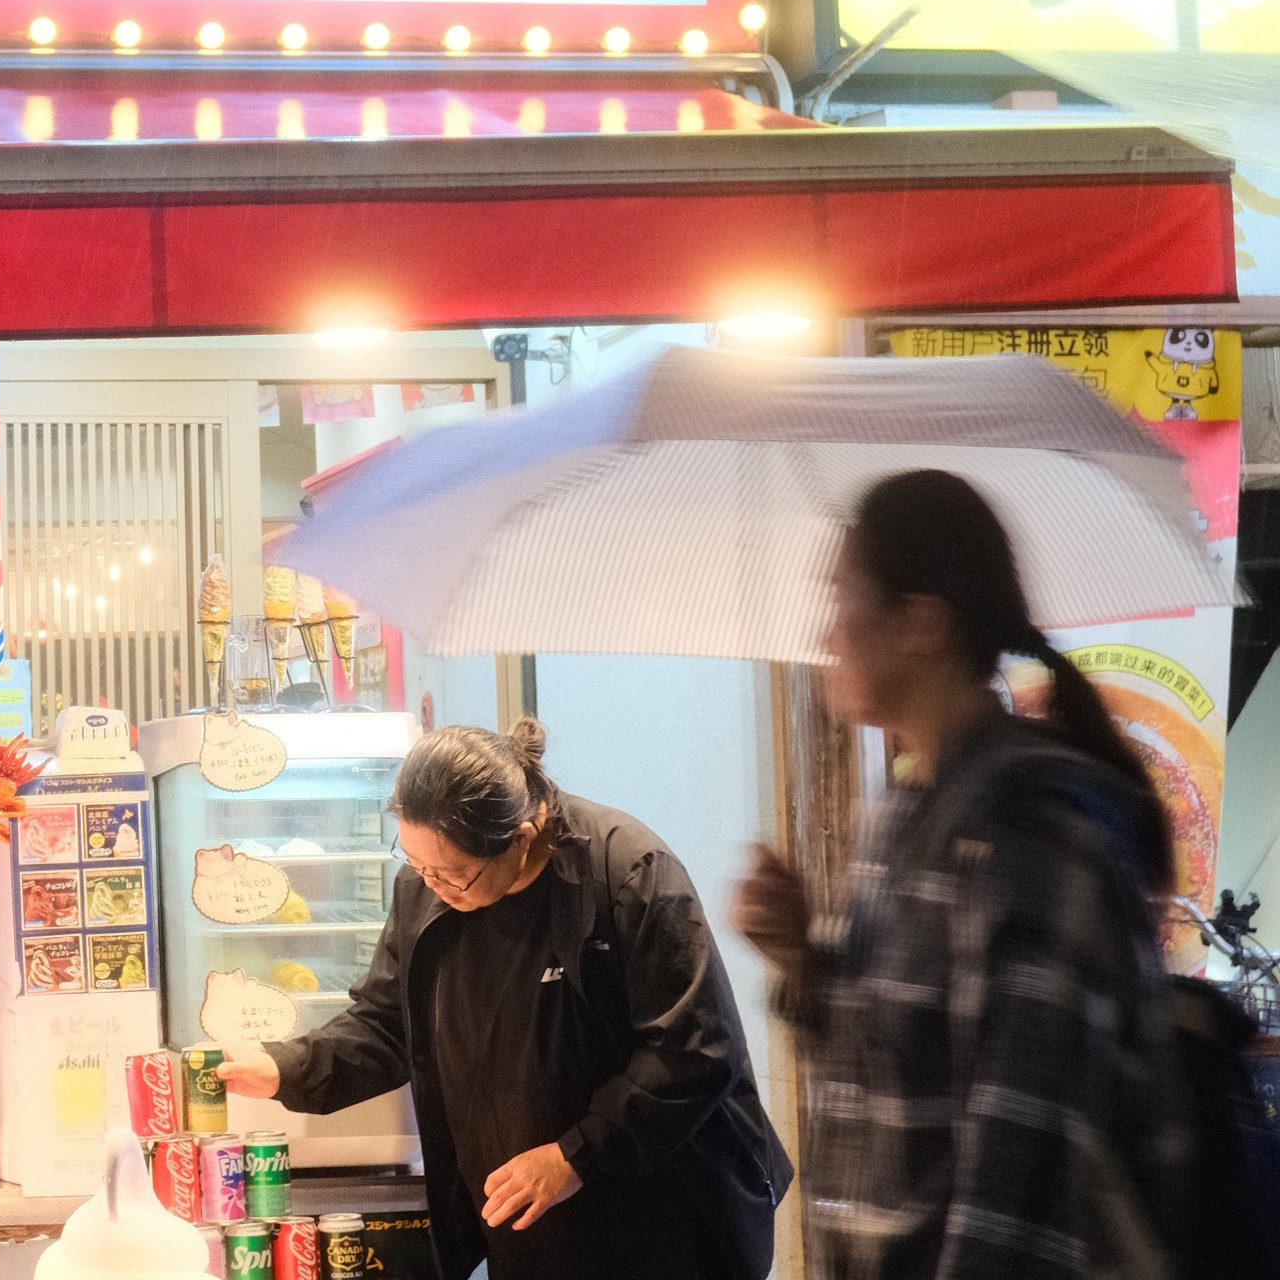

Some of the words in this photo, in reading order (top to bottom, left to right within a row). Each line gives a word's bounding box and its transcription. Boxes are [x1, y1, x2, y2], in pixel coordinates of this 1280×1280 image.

[912, 329, 1109, 357] 新用户注册立领
[59, 1053, 101, 1070] Asahi
[338, 1255, 357, 1264] DRY
